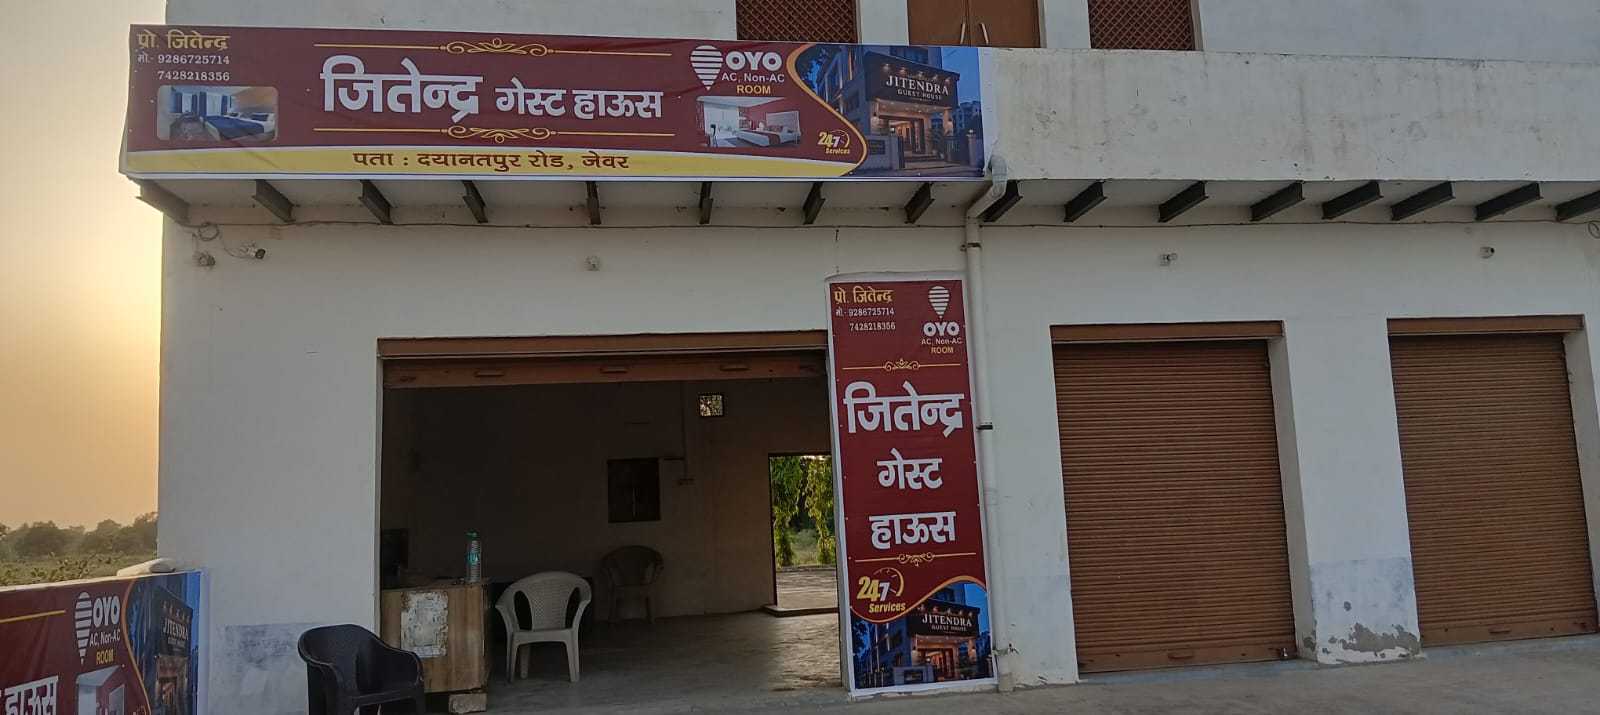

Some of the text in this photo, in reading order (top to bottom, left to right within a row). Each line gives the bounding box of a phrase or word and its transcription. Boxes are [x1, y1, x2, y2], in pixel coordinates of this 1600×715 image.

[165, 29, 231, 51] जितेन्द्र
[158, 54, 230, 64] 9286725714
[725, 51, 783, 71] OYO
[158, 71, 230, 81] 7428218356
[744, 73, 785, 83] Non-AC
[319, 54, 664, 123] जितेन्द्र गेस्ट हाऊस
[736, 84, 771, 94] ROOM
[886, 75, 949, 96] JITENDRA
[353, 152, 393, 166] पता
[417, 153, 521, 172] दयानतपुर
[582, 151, 629, 169] जेवर
[853, 285, 895, 303] जितेन्द्र
[923, 321, 960, 337] OYO
[935, 337, 962, 345] Non-AC
[931, 346, 954, 354] ROOM
[843, 380, 965, 438] जितेन्द्र
[876, 447, 943, 490] गेस्ट
[868, 511, 957, 549] हाऊस
[93, 595, 120, 628] OYO
[869, 602, 906, 613] Services
[922, 613, 972, 627] JITENDRA
[100, 629, 121, 646] Non-AC
[96, 649, 114, 665] ROOM
